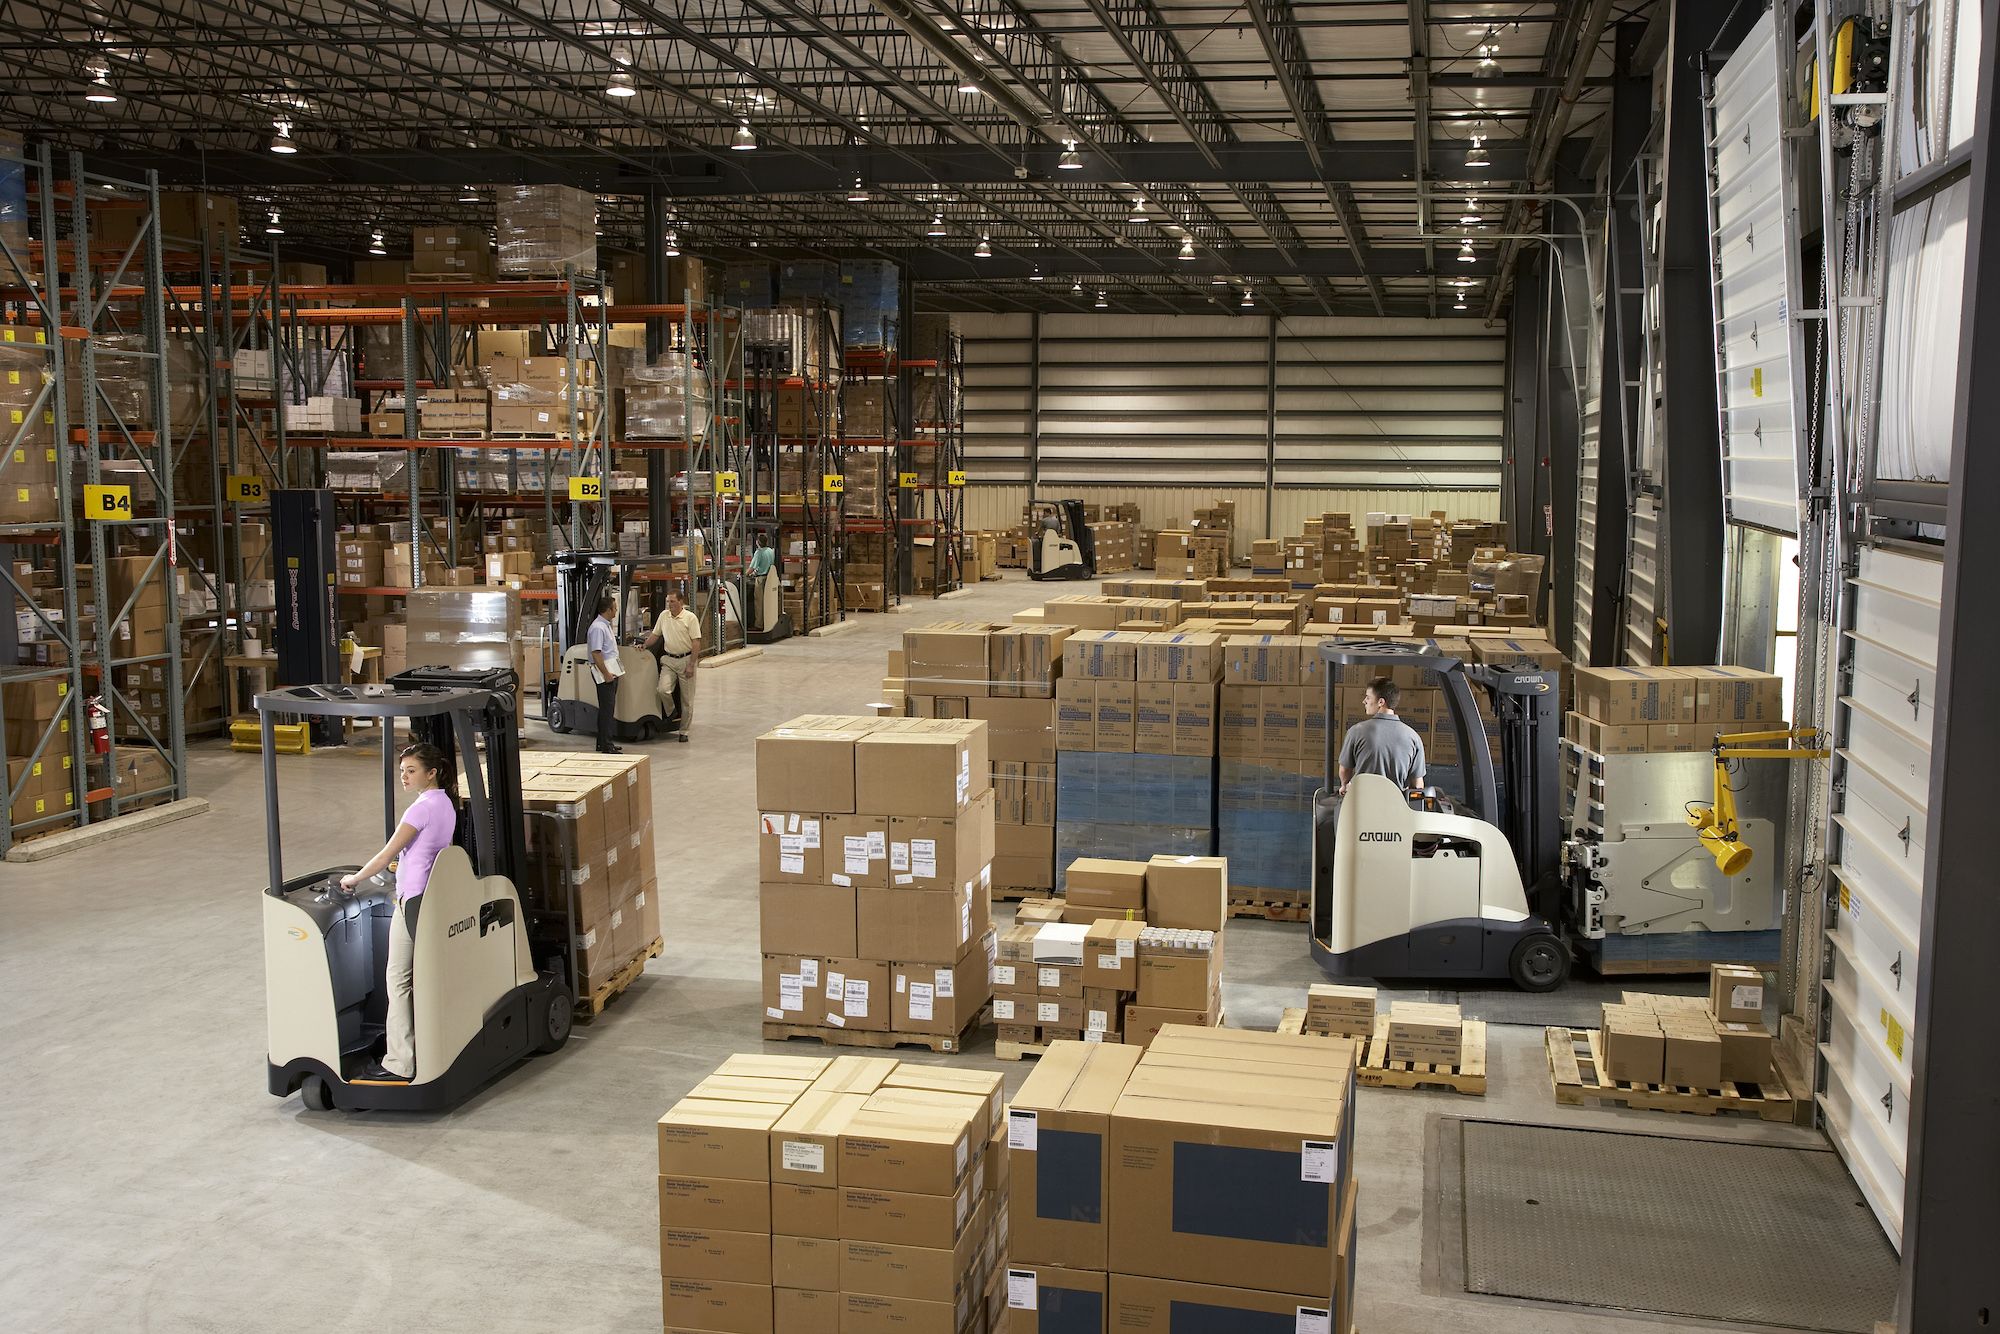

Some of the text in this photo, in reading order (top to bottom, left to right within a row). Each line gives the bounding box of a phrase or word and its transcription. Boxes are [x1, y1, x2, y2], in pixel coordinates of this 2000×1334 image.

[723, 478, 736, 488] B1
[830, 479, 843, 488] A6
[905, 476, 917, 485] A5
[241, 483, 261, 496] B3
[581, 483, 599, 495] B2
[102, 494, 130, 512] B4
[1514, 675, 1544, 683] CROWN
[1359, 832, 1402, 842] CROWN
[448, 916, 476, 938] CROWN
